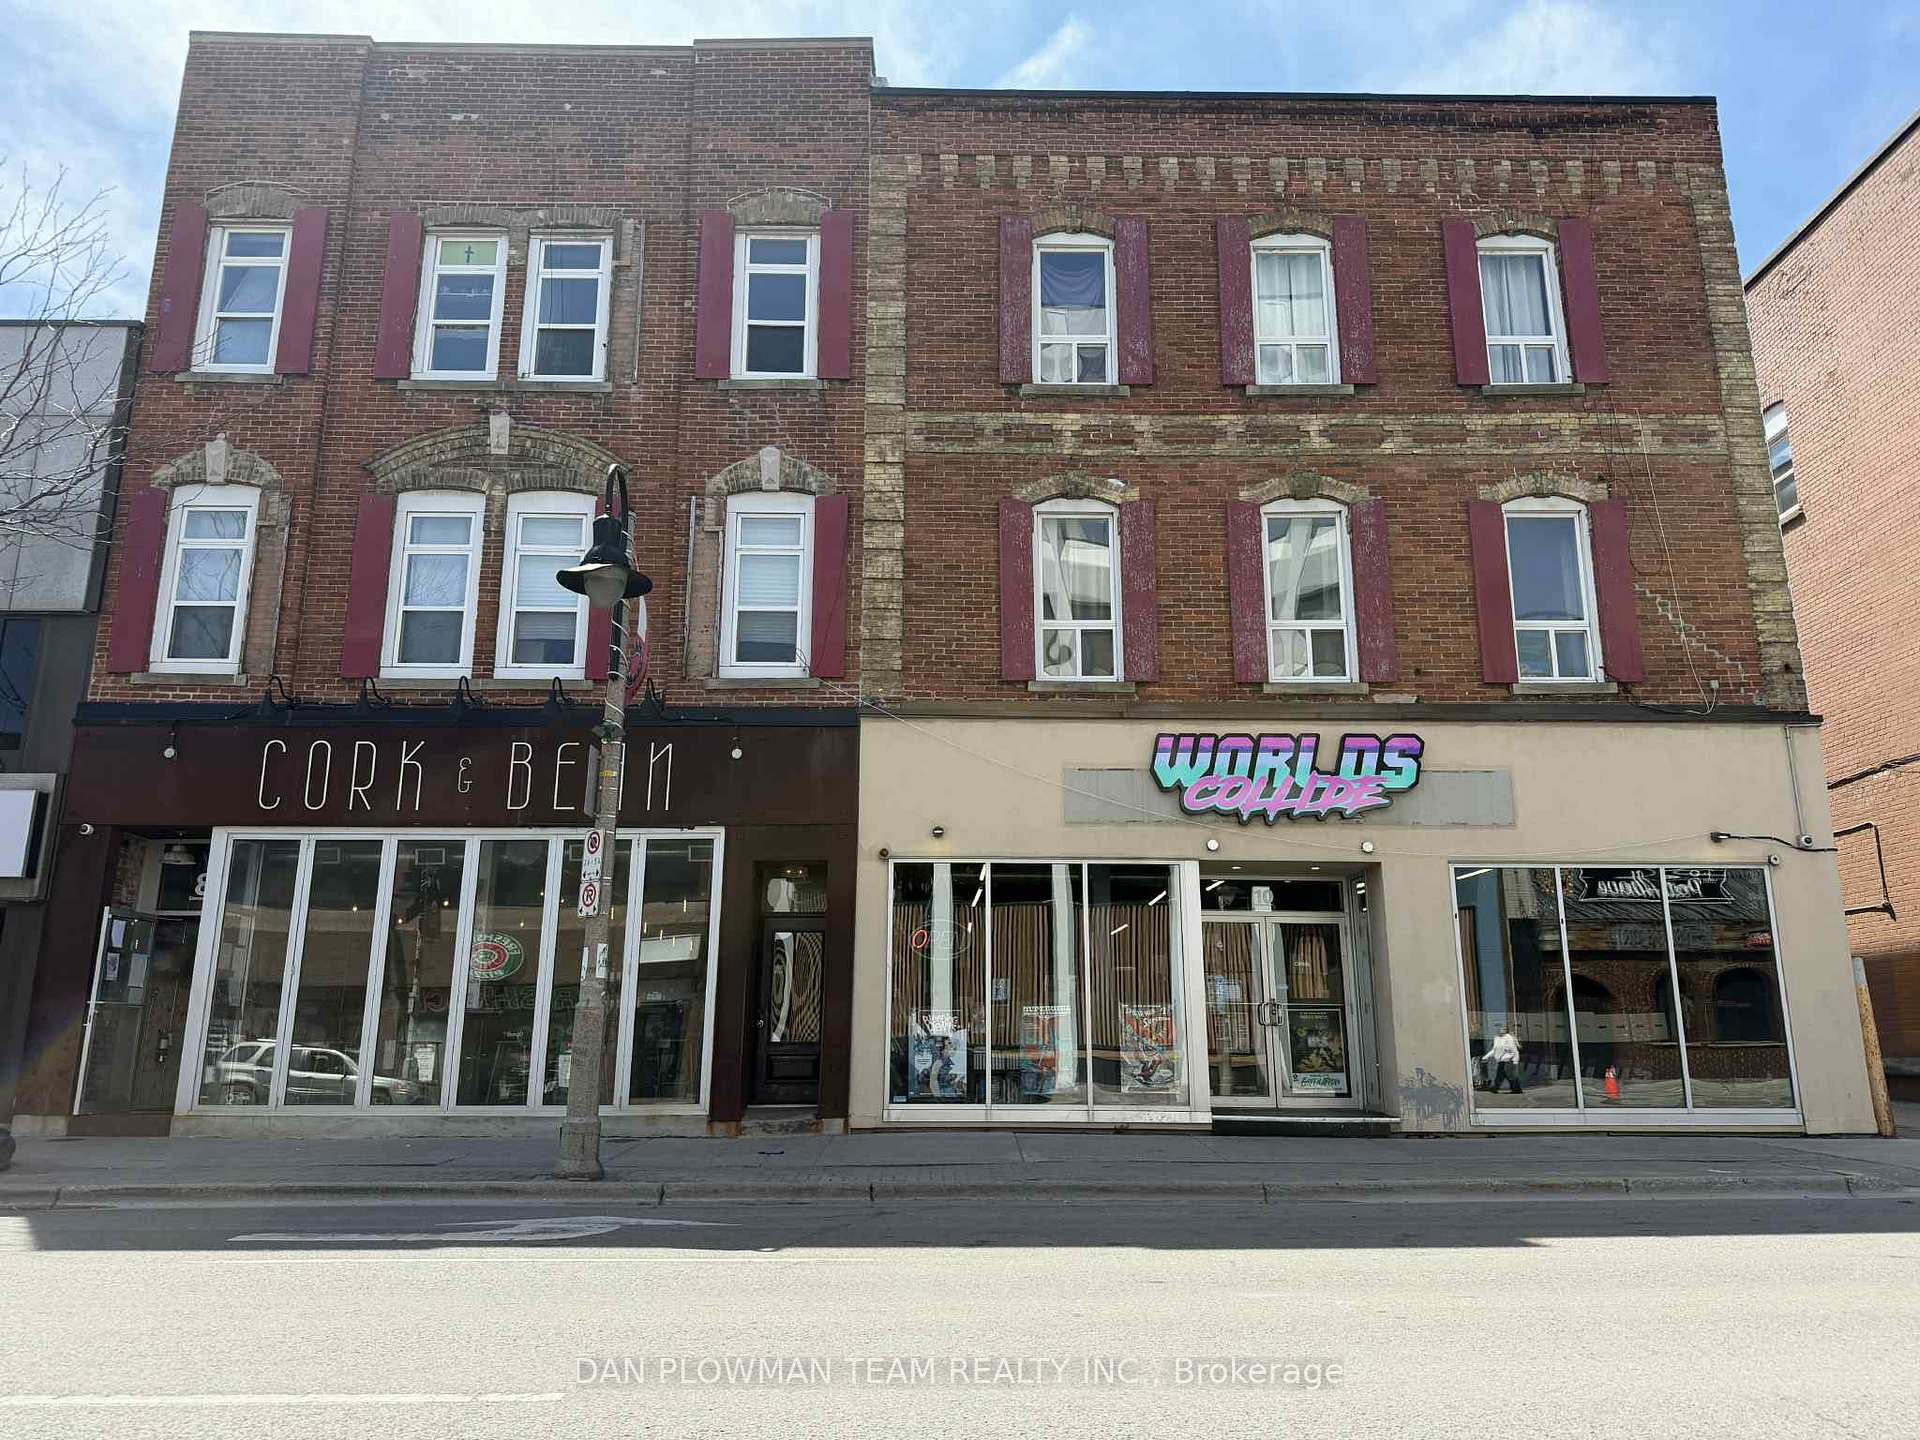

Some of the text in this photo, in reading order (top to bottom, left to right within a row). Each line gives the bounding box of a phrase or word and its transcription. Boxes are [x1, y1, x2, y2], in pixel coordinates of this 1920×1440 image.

[258, 740, 673, 811] CORK & BEN
[1153, 735, 1422, 789] WORLDS
[1184, 770, 1393, 821] COLLIDE
[1253, 888, 1274, 904] 10
